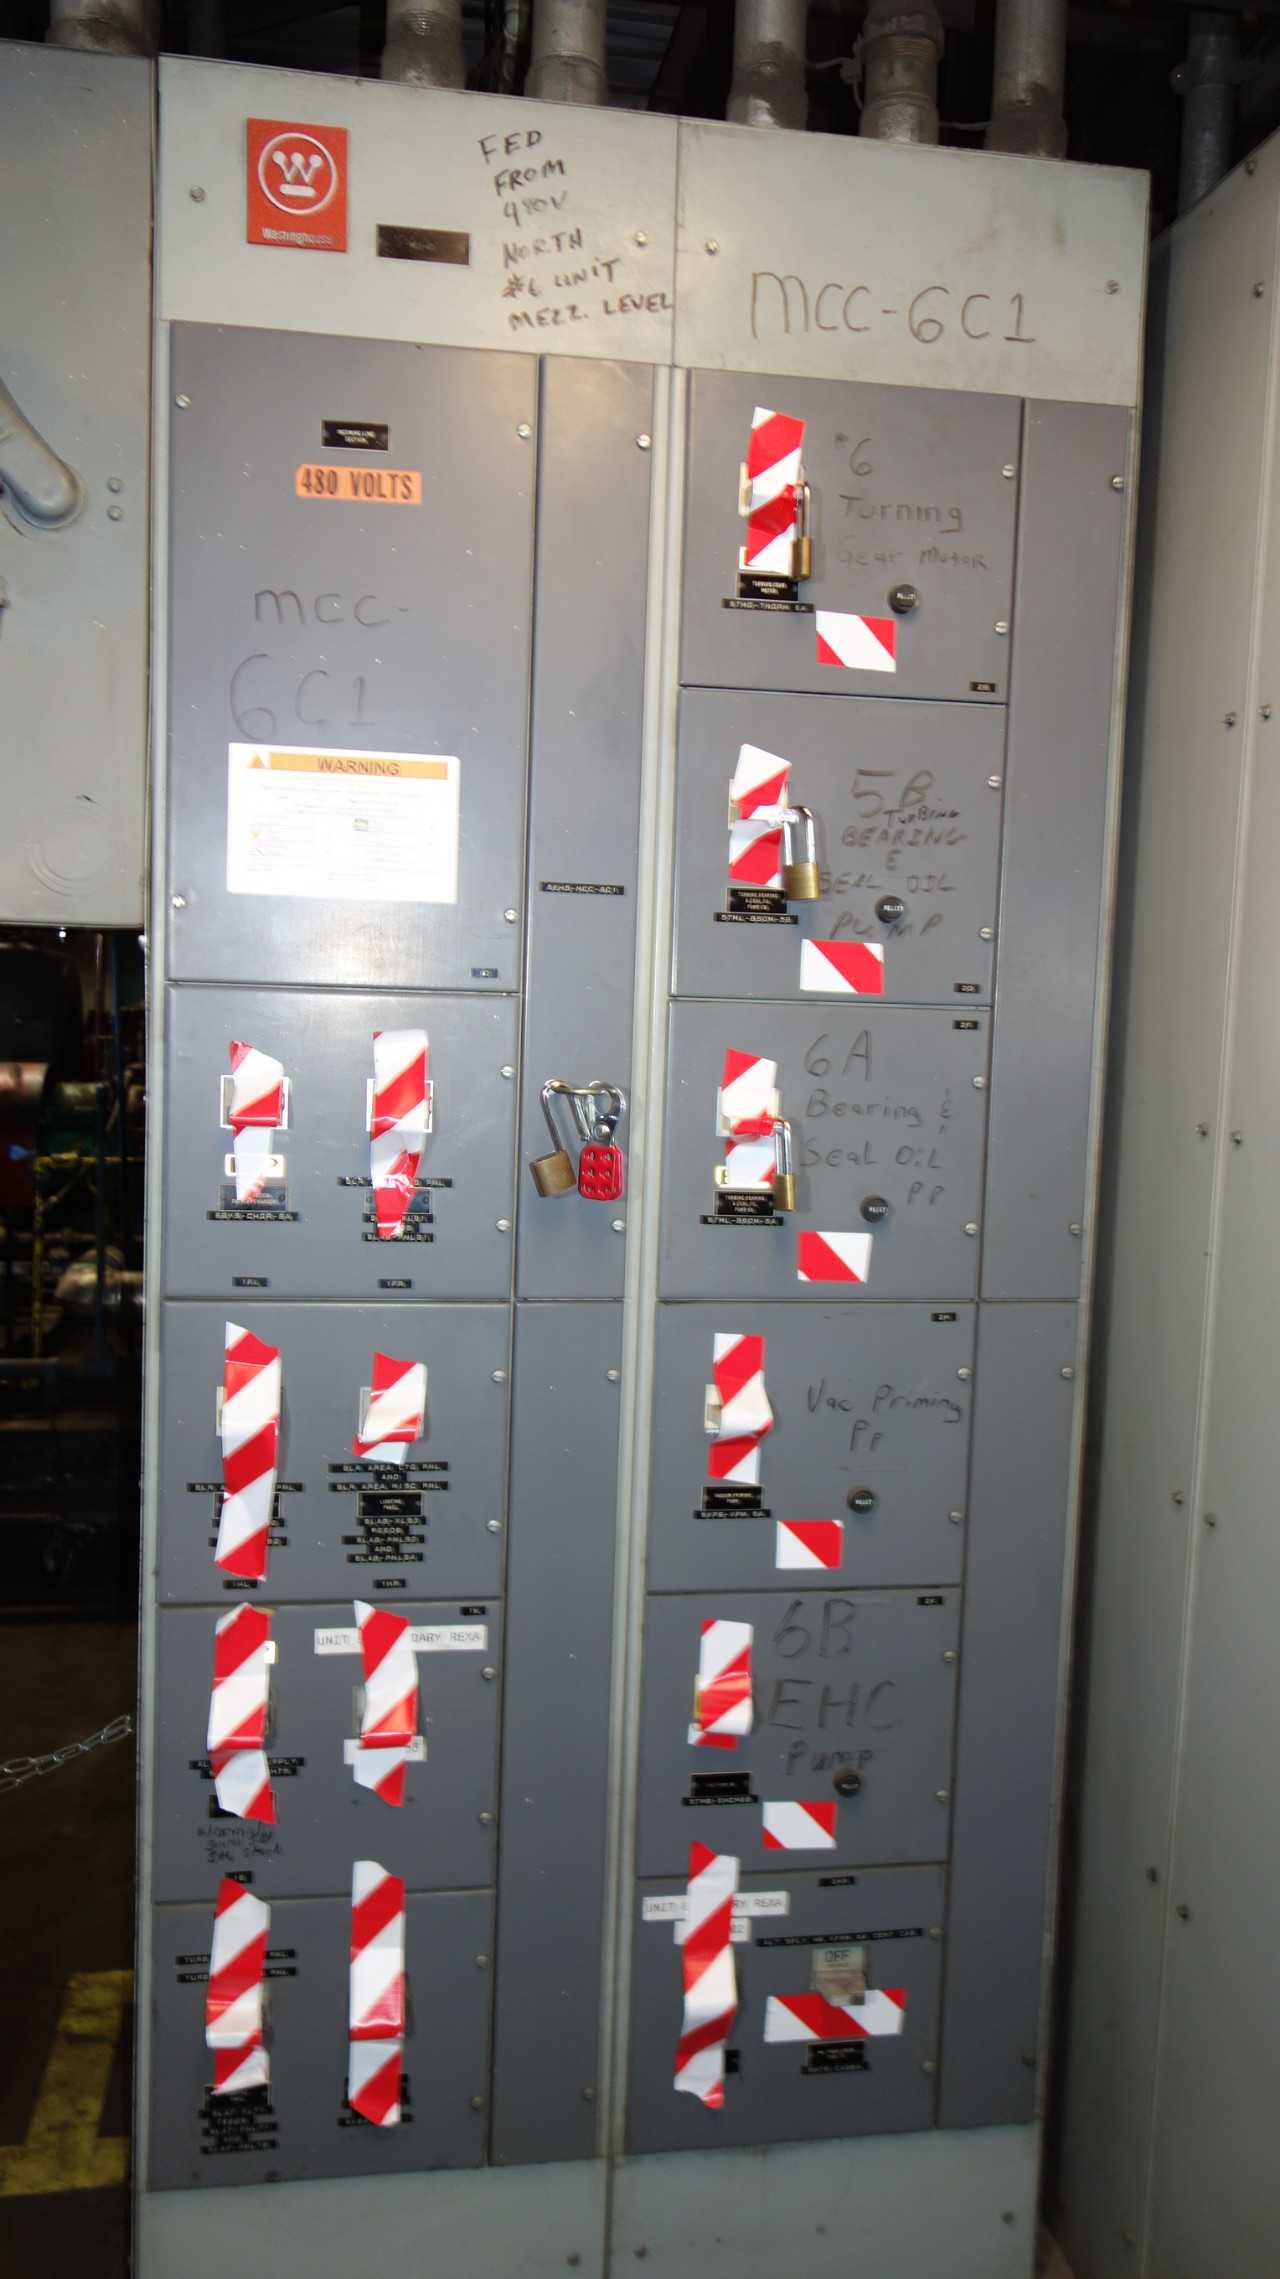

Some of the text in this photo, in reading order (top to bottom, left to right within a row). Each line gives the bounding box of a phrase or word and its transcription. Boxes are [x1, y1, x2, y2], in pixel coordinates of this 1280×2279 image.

[478, 130, 542, 165] FED
[494, 159, 565, 196] FROM
[262, 227, 331, 246] Westinghouse
[502, 227, 583, 268] NORTH
[602, 292, 674, 316] LEVEL
[302, 468, 413, 500] 480 VOLTS
[838, 494, 962, 534] Turning
[317, 756, 401, 777] WARNING
[841, 825, 967, 848] BEARING
[804, 1030, 873, 1082] 6A
[806, 1088, 924, 1129] Bearing
[807, 1378, 962, 1425] Vac Priming
[773, 1599, 856, 1660] 6B
[768, 1678, 904, 1732] EHC
[825, 1949, 850, 1963] OFF
